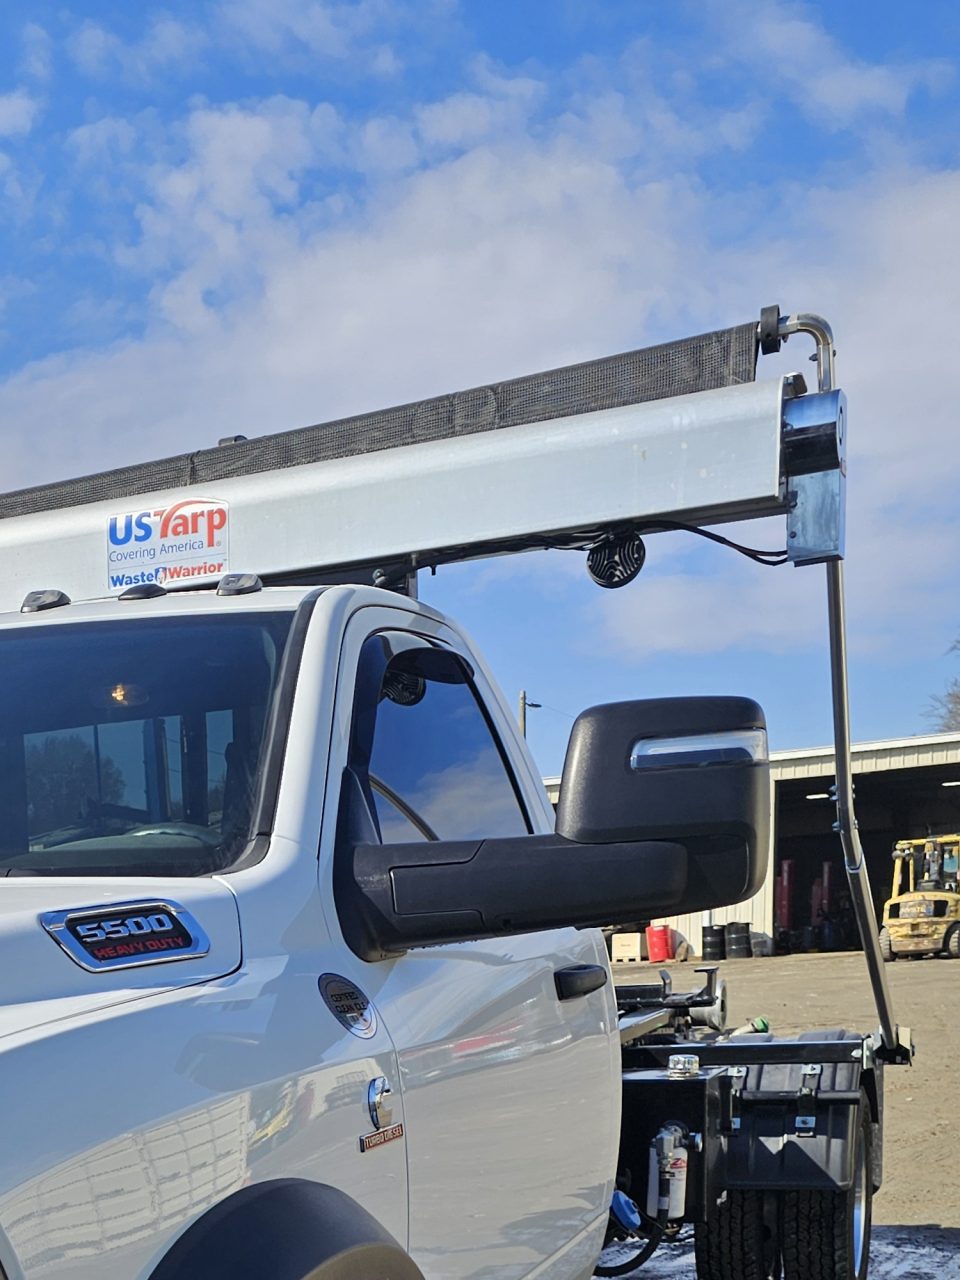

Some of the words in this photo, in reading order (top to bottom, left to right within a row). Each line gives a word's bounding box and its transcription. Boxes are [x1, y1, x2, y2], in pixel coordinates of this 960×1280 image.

[109, 546, 156, 562] Covering
[159, 540, 204, 556] America
[110, 571, 156, 588] Waste
[167, 561, 223, 579] Warrior
[76, 914, 174, 942] 5500
[94, 942, 144, 959] HEAVY
[145, 936, 184, 951] DUTY
[365, 1132, 384, 1148] TURBO
